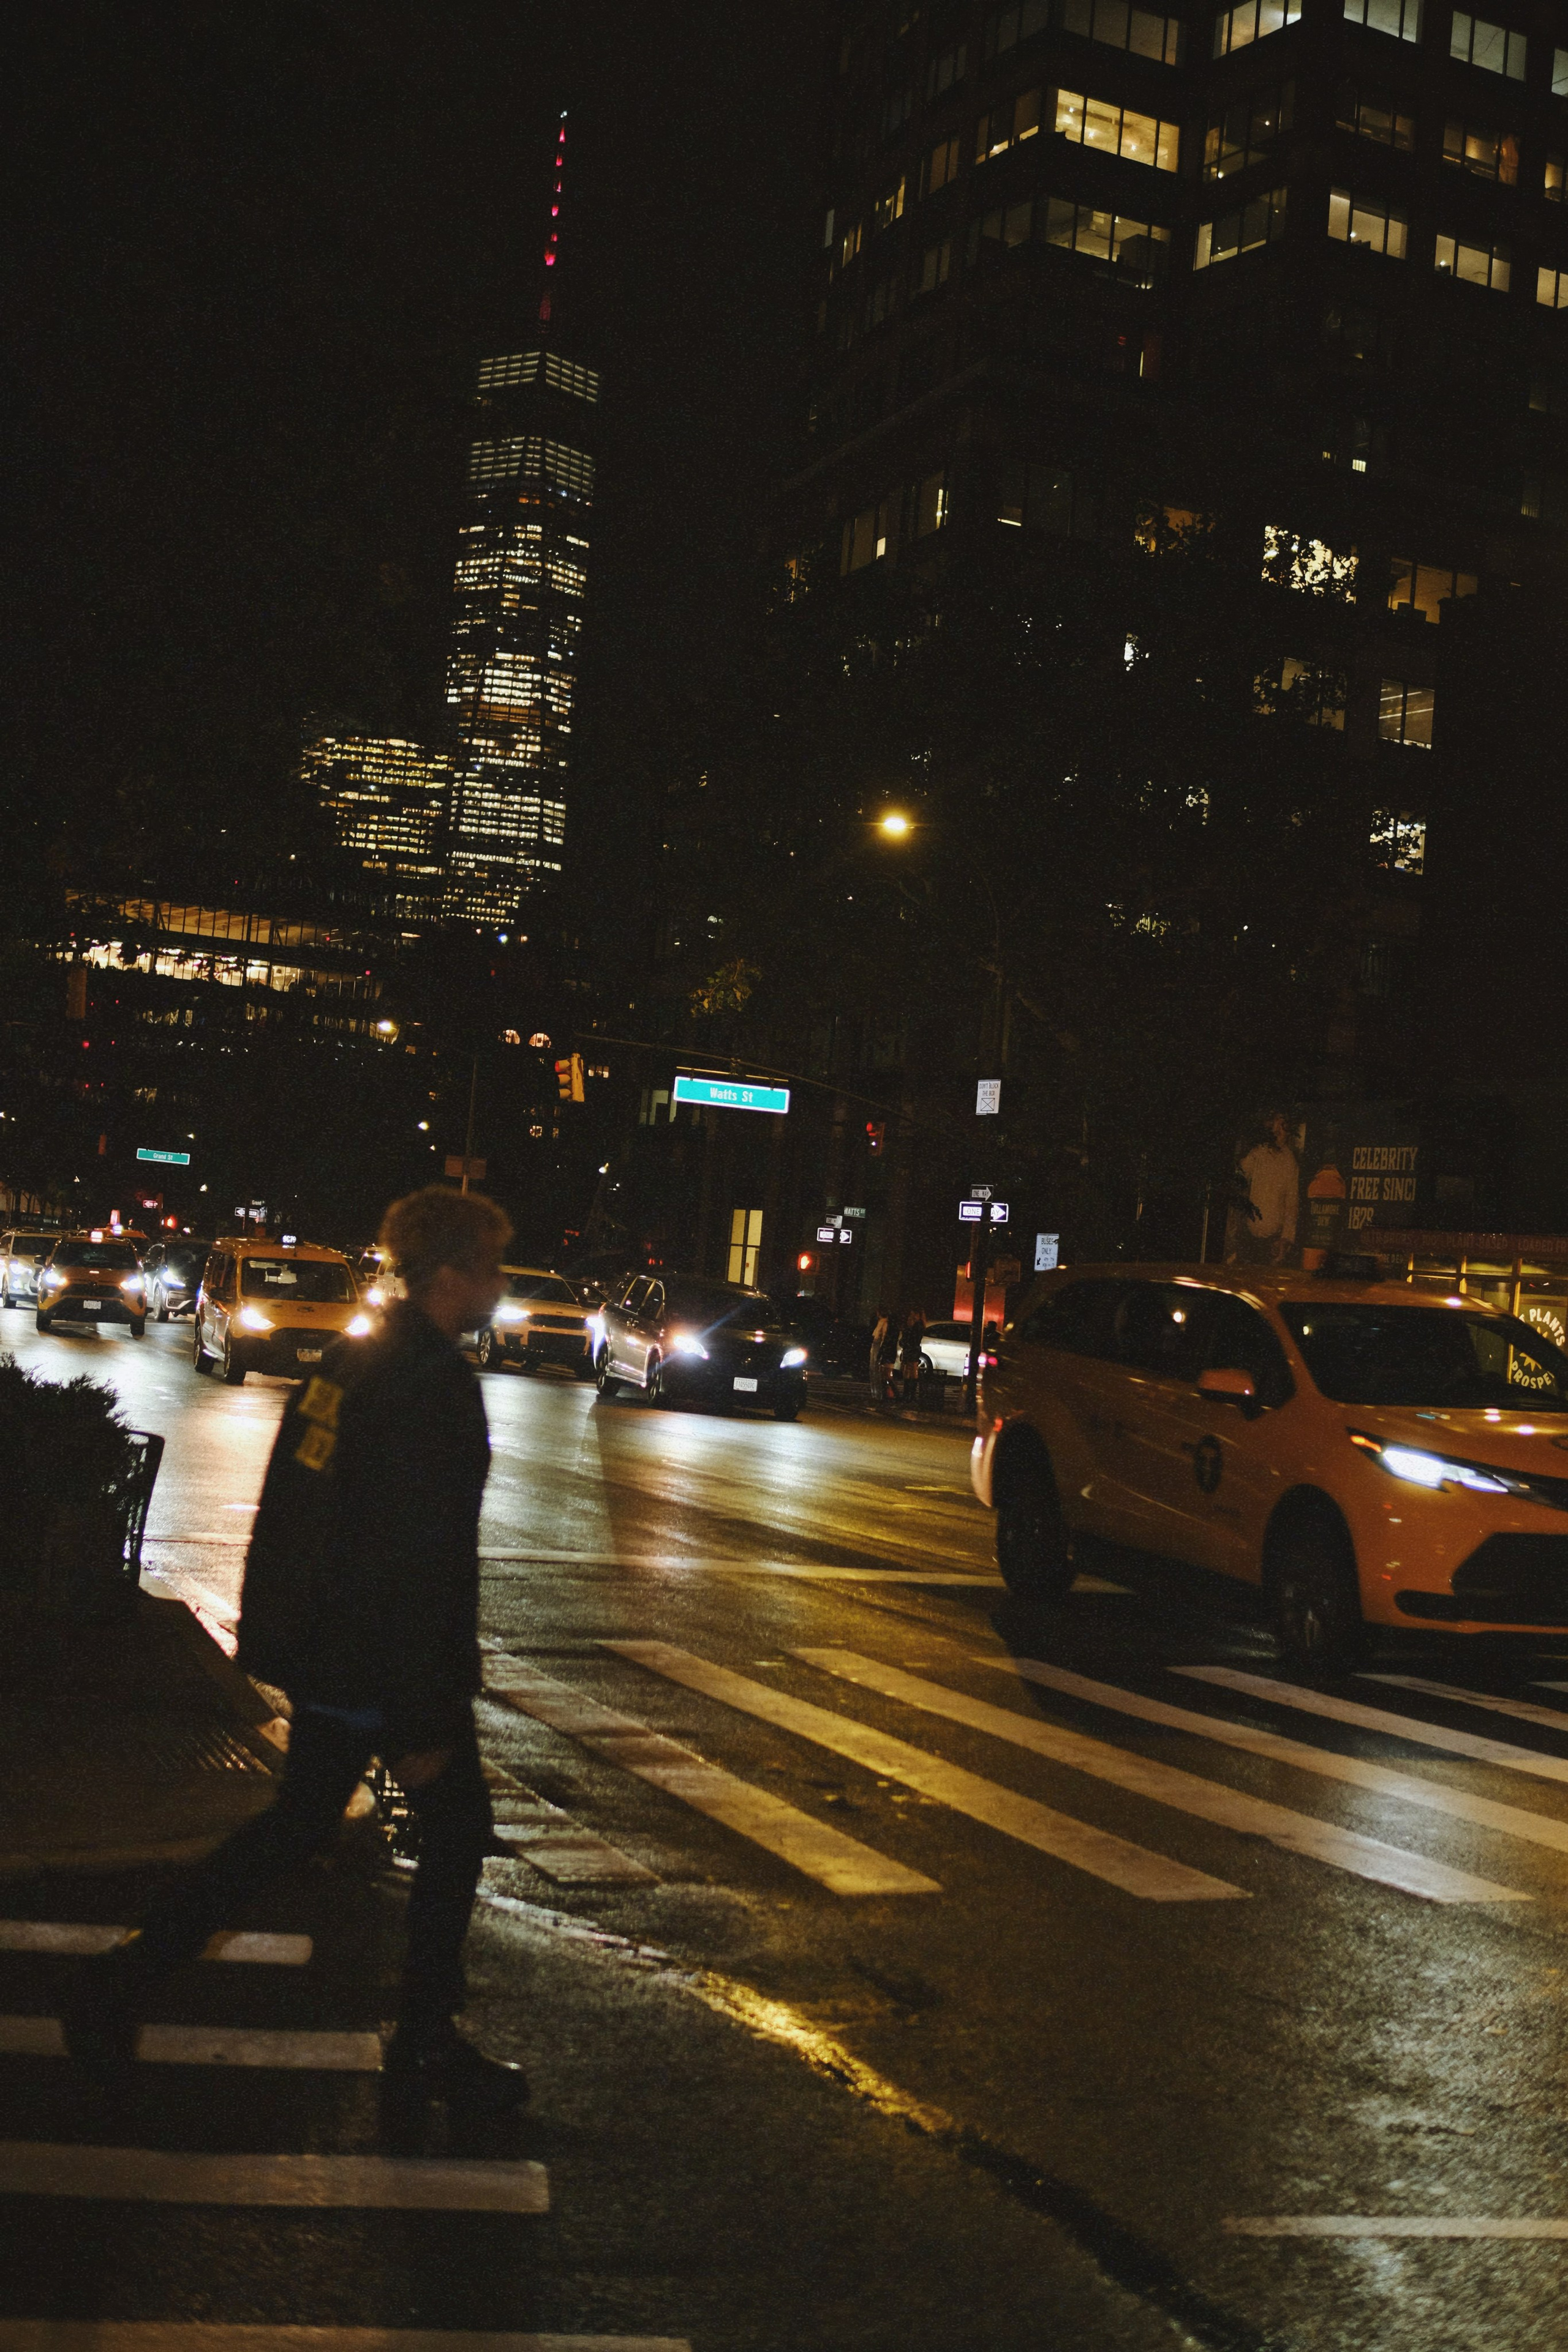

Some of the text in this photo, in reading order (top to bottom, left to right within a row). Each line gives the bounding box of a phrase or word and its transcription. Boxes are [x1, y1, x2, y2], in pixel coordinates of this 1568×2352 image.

[709, 1087, 754, 1102] Watts St
[1352, 1146, 1419, 1171] CELEBRITY
[1349, 1177, 1381, 1200] FREE
[844, 1207, 859, 1216] WATTS
[1517, 1238, 1553, 1253] LOADED
[1529, 1308, 1566, 1346] PLANTS
[1512, 1360, 1555, 1390] PROSPE
